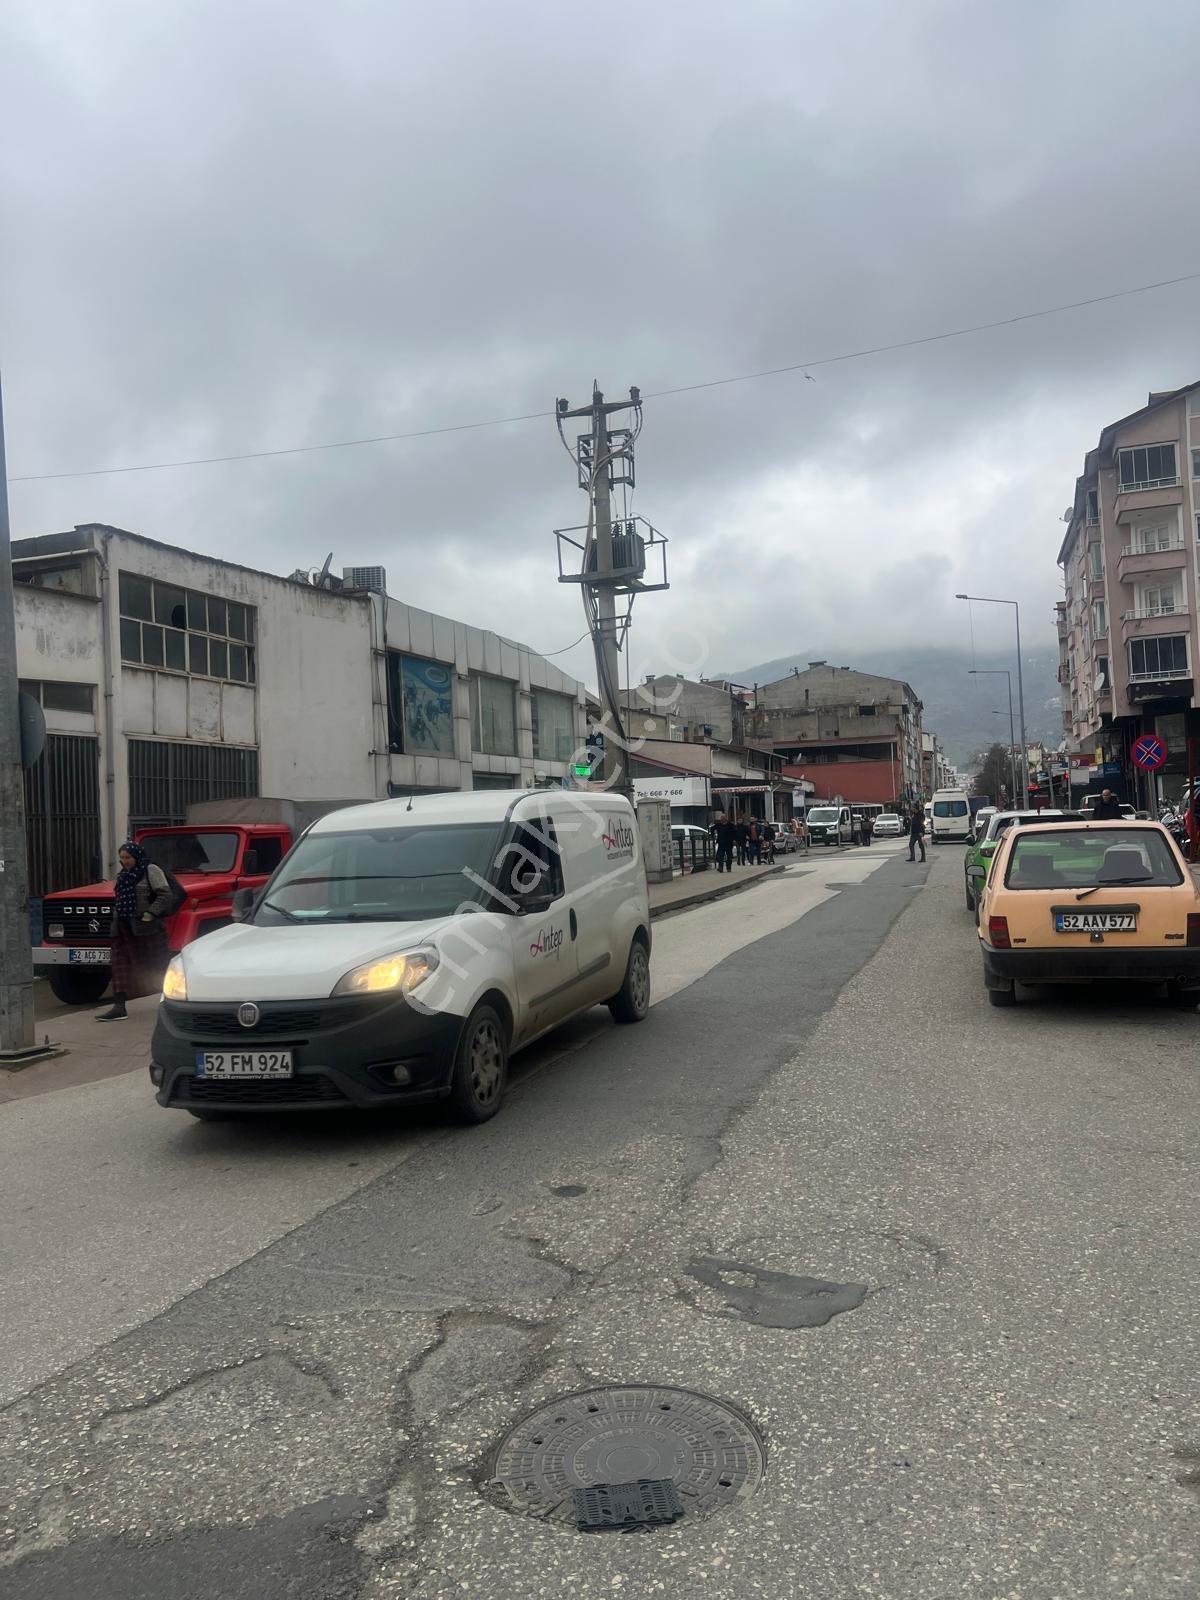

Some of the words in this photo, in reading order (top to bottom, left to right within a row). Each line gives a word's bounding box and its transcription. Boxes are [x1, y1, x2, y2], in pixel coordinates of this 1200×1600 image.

[602, 818, 634, 856] Antep
[63, 906, 111, 914] DODG
[1063, 915, 1079, 928] 52
[1083, 915, 1108, 928] AAV
[1109, 915, 1134, 928] 577
[530, 925, 563, 960] Antep
[73, 950, 82, 960] 52
[205, 1055, 225, 1072] 52
[231, 1055, 254, 1072] FM
[258, 1054, 290, 1072] 924
